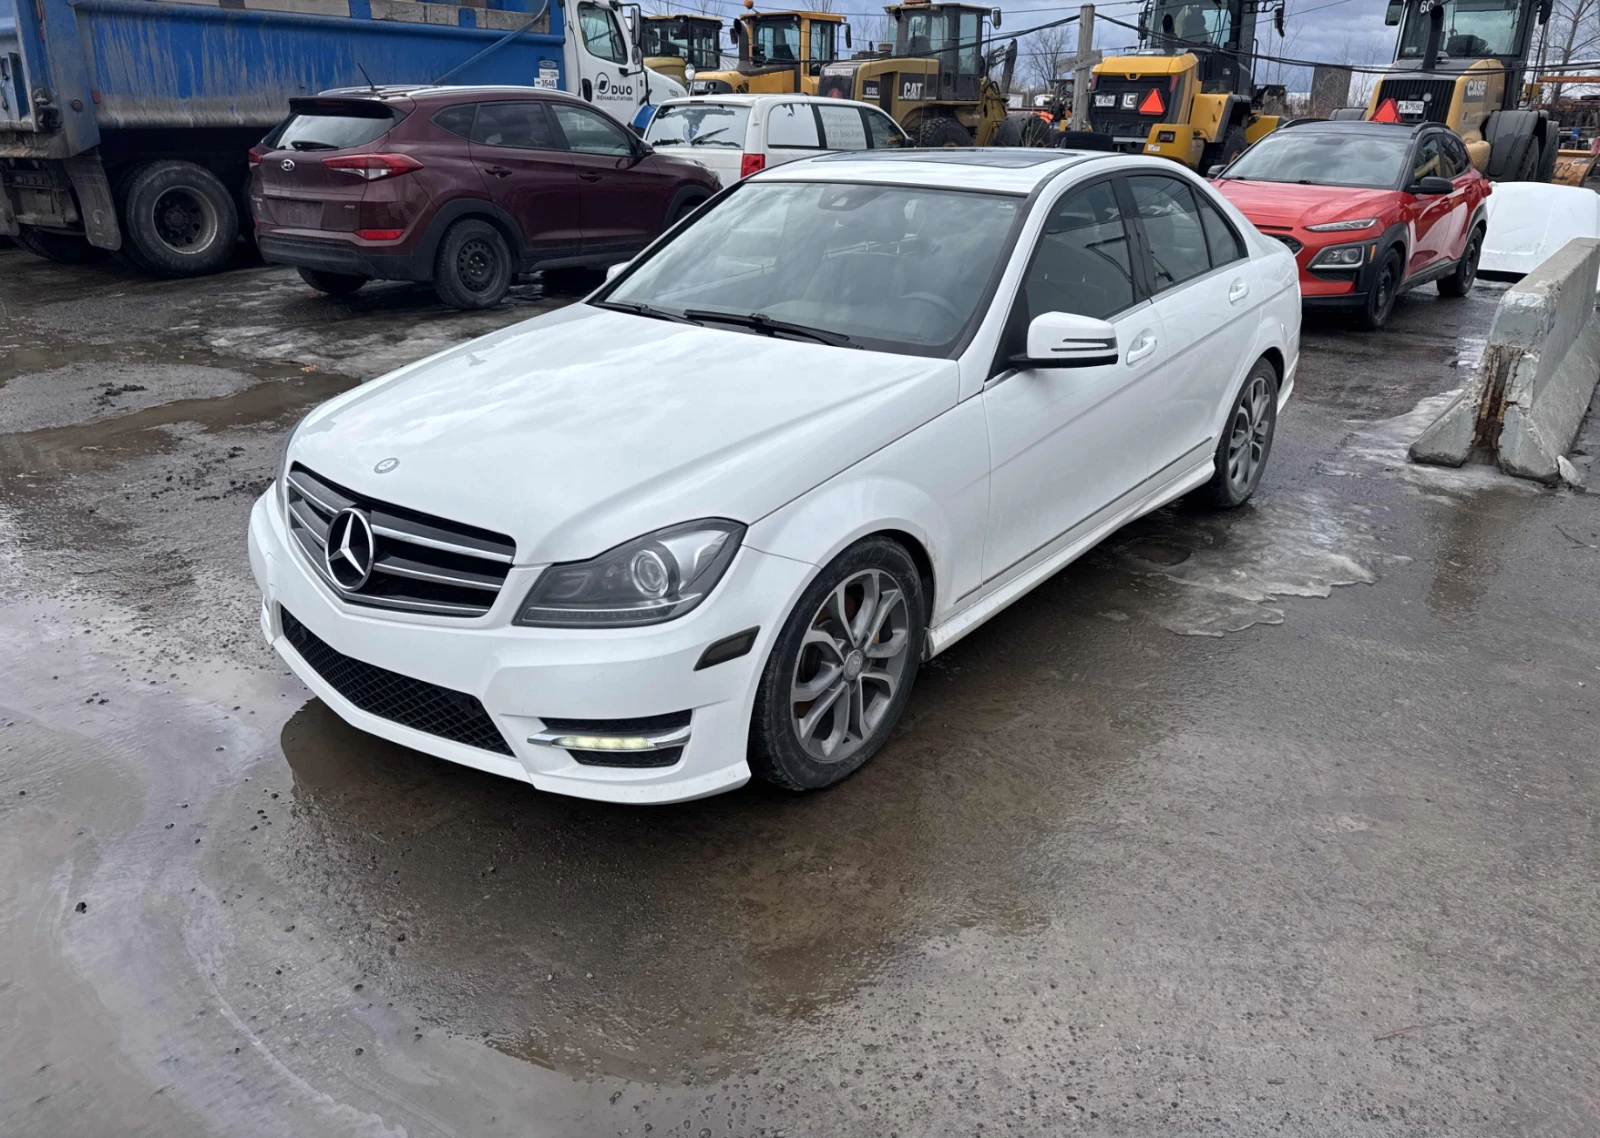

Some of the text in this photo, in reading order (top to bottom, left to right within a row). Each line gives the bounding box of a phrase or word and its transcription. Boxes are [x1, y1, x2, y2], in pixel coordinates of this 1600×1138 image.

[611, 85, 632, 95] DUO
[904, 82, 922, 98] CAT
[1467, 79, 1486, 96] CASE
